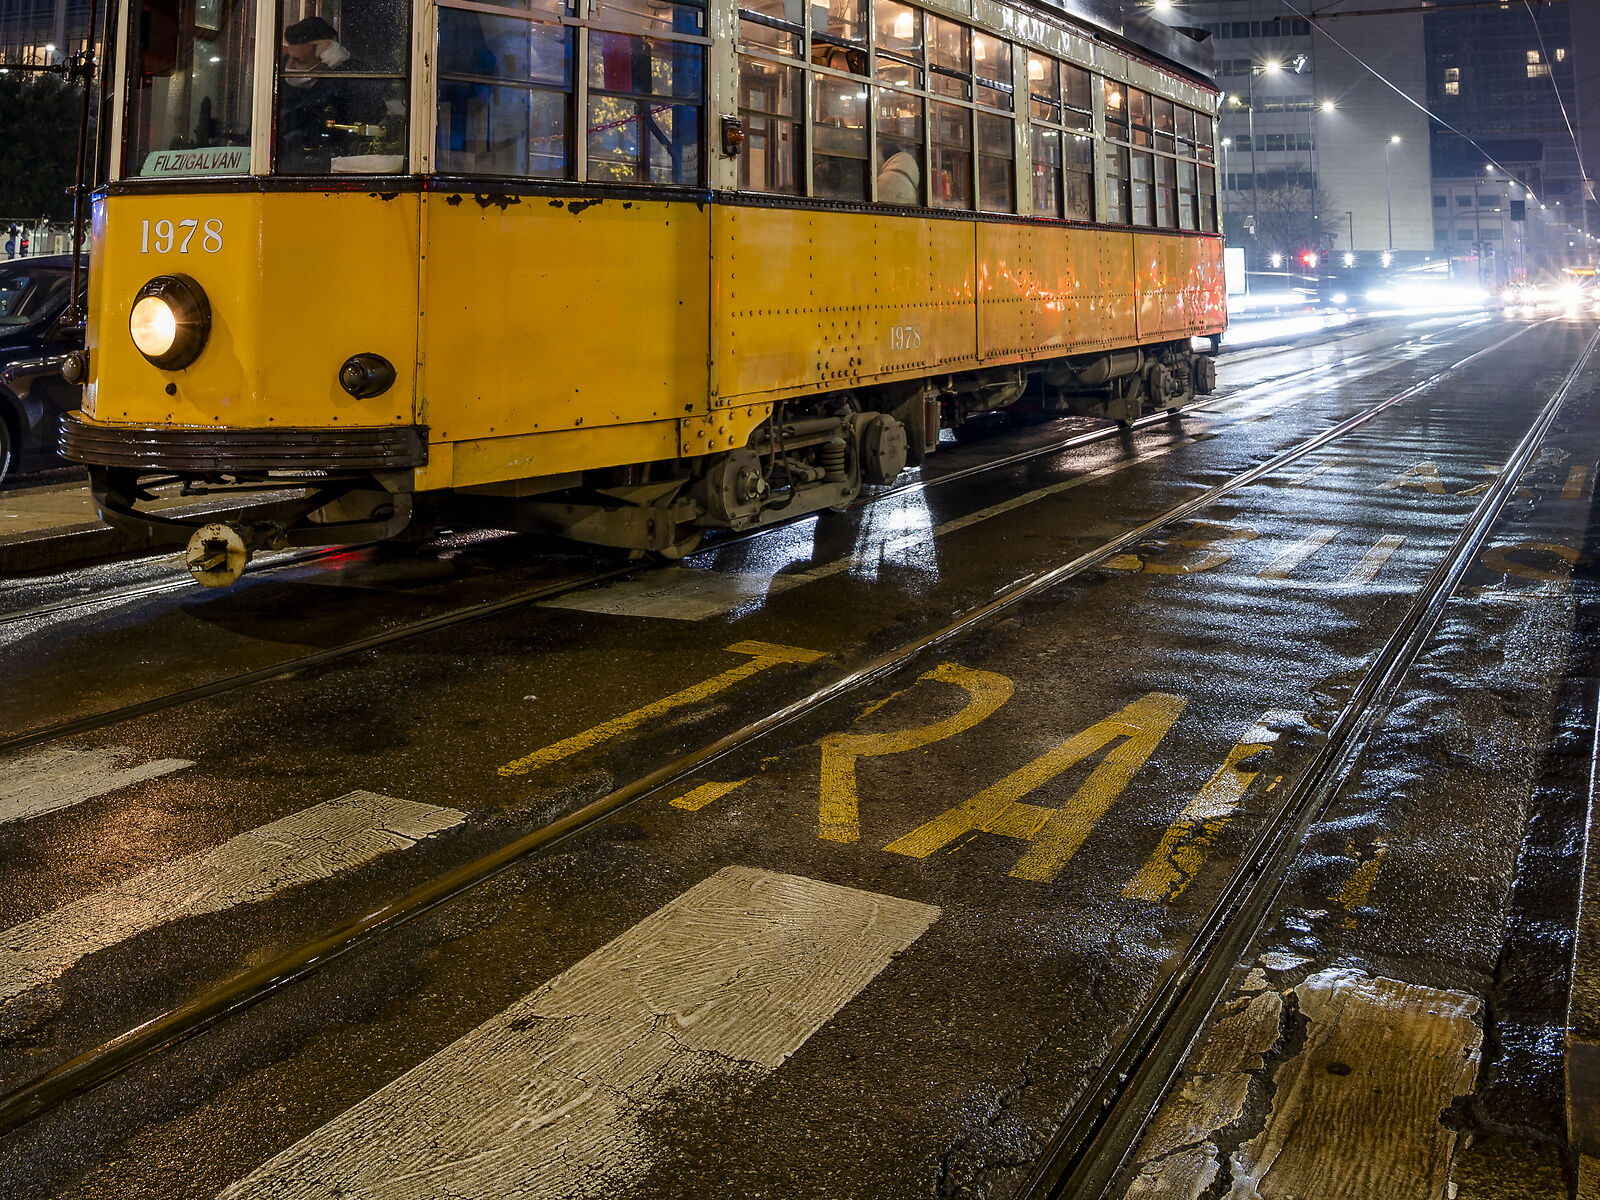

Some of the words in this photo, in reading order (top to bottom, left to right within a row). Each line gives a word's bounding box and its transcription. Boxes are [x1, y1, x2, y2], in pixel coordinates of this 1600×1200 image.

[153, 151, 242, 172] FILZI/GALVANI
[141, 218, 224, 254] 1978
[890, 325, 921, 350] 1978
